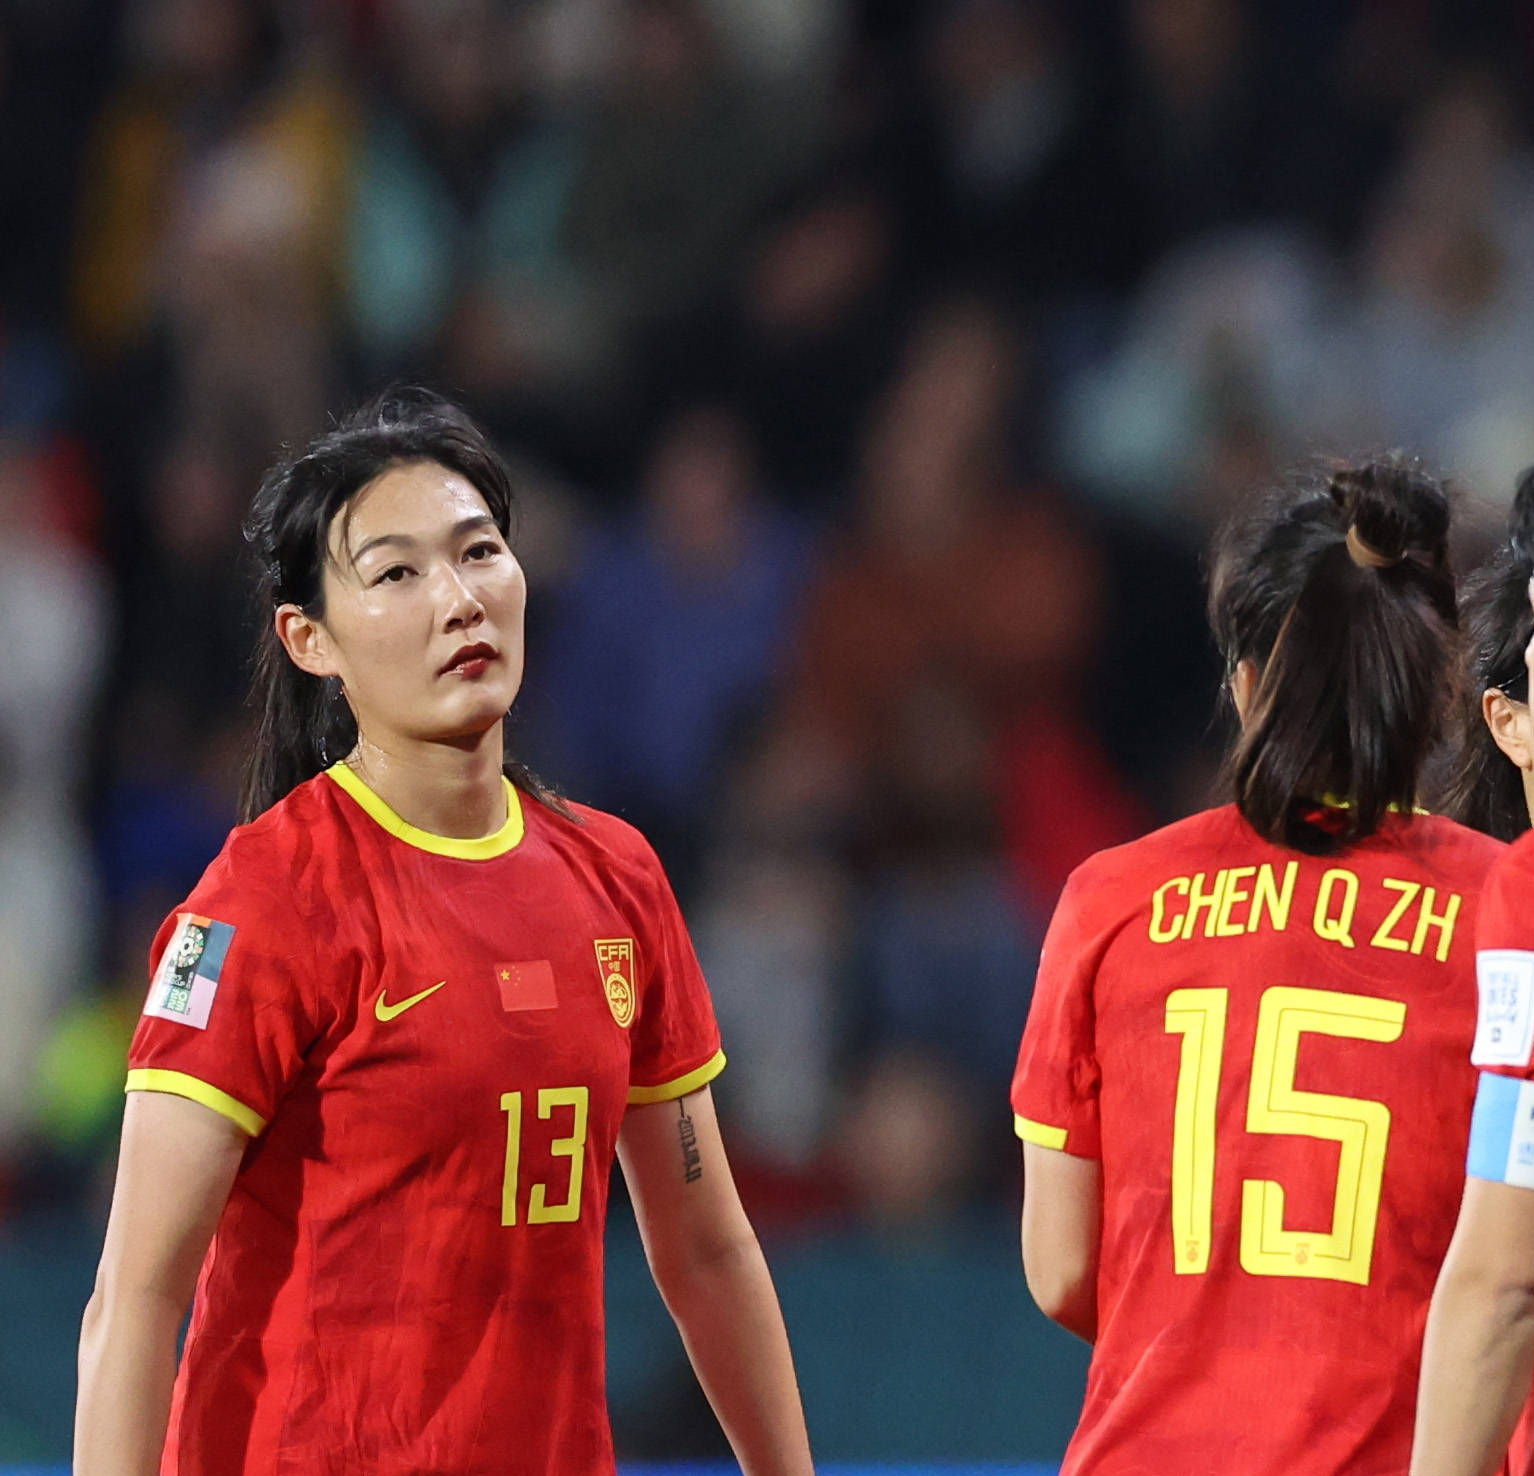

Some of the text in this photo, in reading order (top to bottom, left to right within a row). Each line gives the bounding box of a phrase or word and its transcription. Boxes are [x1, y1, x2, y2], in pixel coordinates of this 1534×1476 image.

[598, 944, 629, 960] CFA
[1148, 860, 1462, 963] CHEN Q ZH
[500, 1086, 589, 1226] 13
[1164, 985, 1407, 1286] 15
